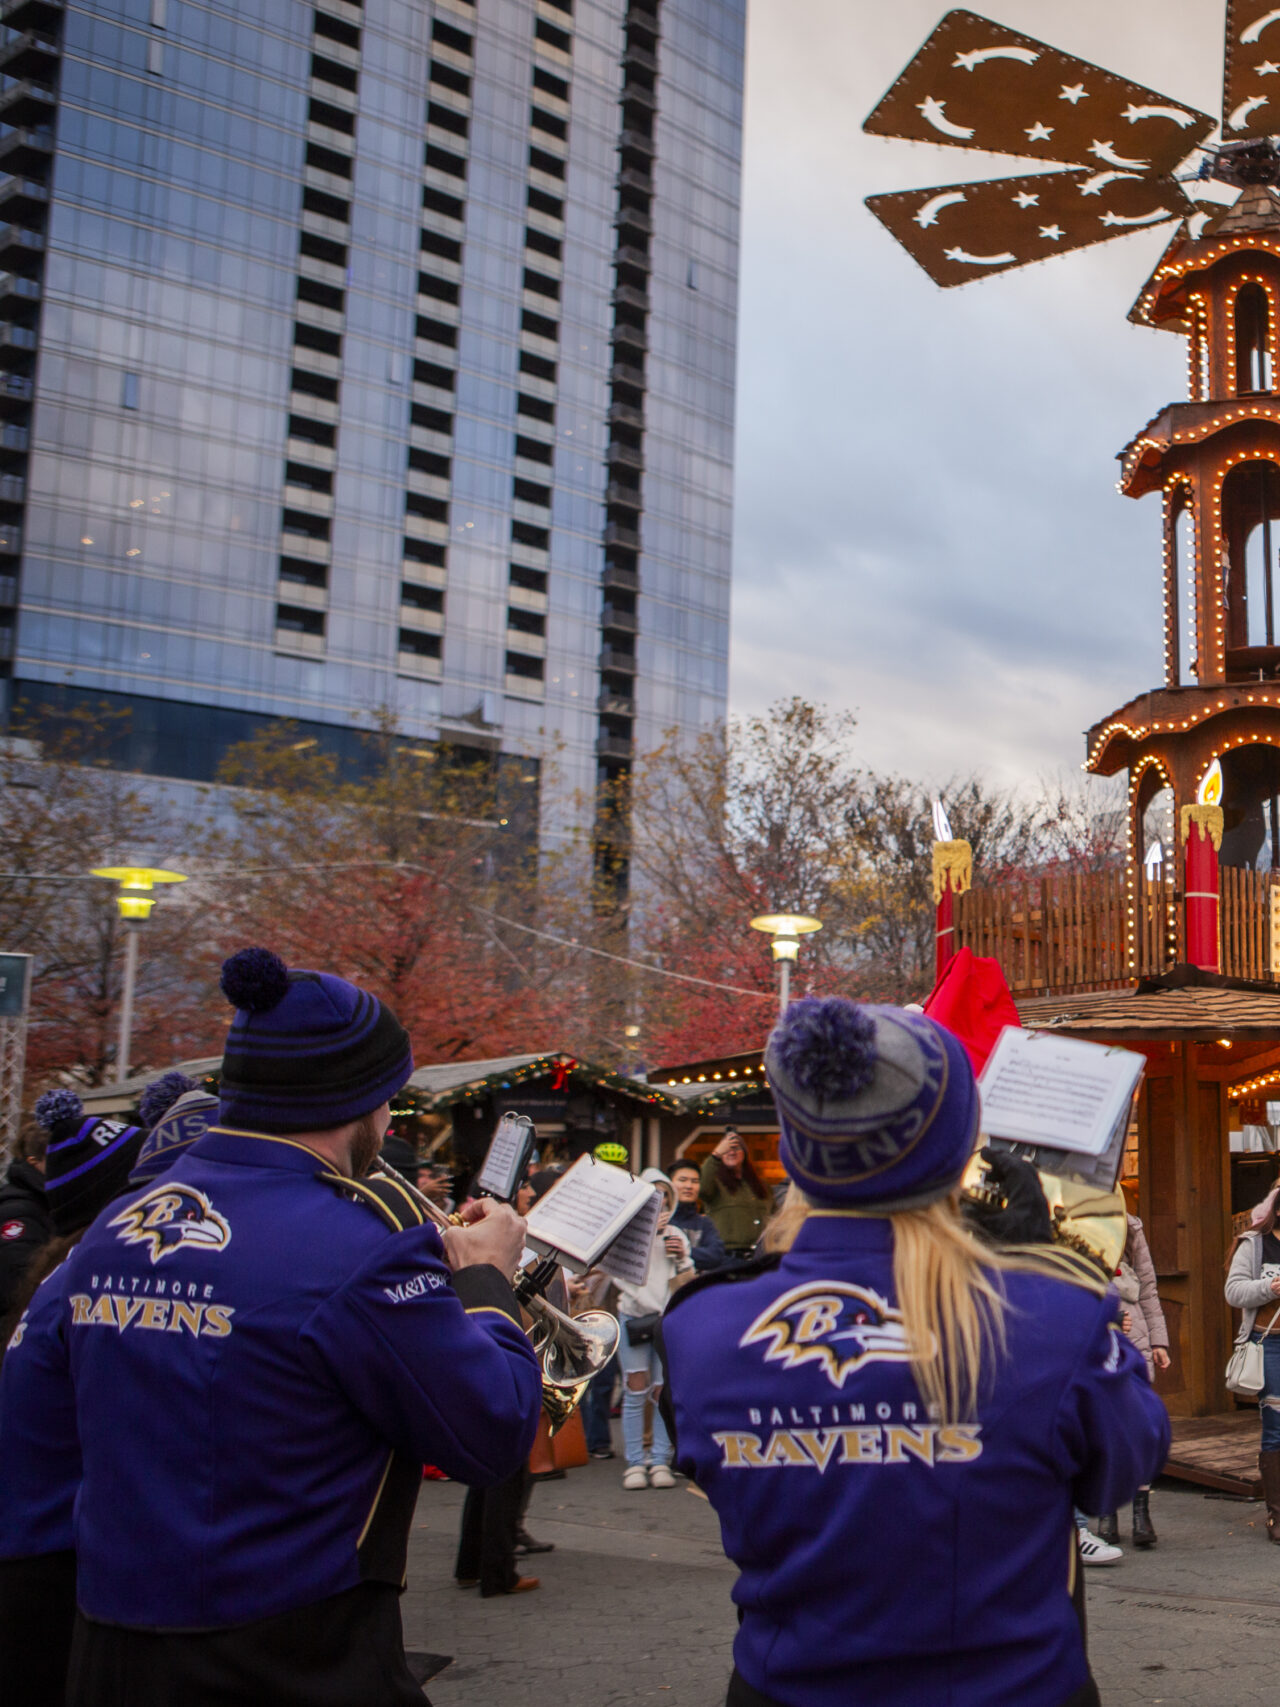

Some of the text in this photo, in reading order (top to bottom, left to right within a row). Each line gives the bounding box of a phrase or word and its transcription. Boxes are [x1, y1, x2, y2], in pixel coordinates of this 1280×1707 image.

[91, 1275, 215, 1299] BALTIMORE
[383, 1274, 428, 1304] M&T
[69, 1293, 236, 1338] RAVENS
[749, 1401, 943, 1426] BALTIMORE
[711, 1423, 984, 1475] RAVENS
